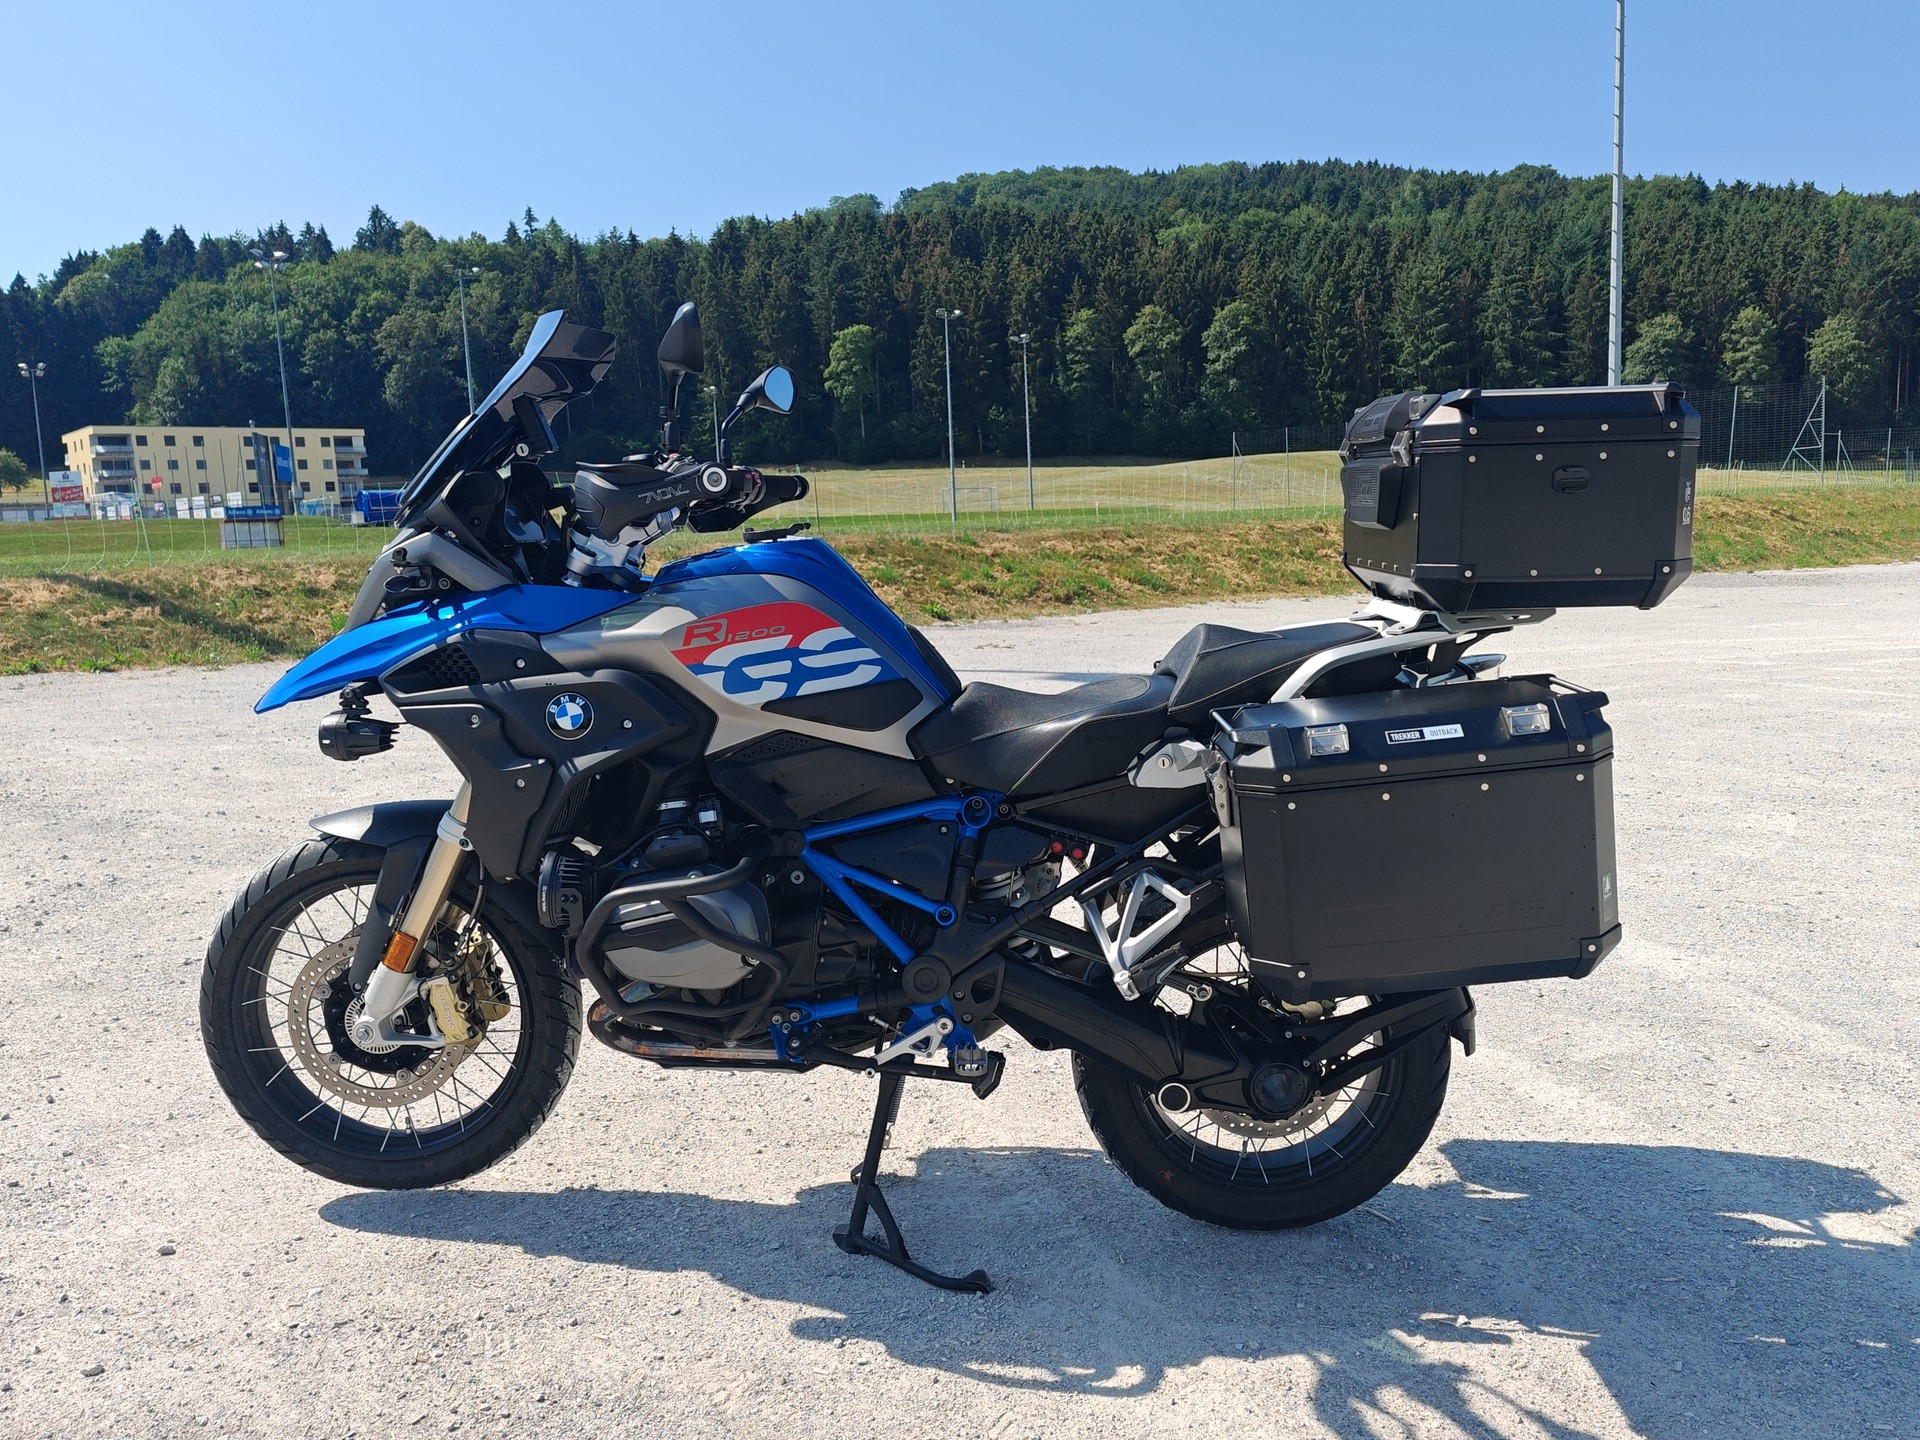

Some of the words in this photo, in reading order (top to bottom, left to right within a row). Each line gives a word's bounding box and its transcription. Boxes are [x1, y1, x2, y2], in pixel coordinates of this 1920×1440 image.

[645, 484, 683, 504] ADV
[697, 626, 882, 706] GS
[549, 695, 586, 713] BMW
[1390, 731, 1421, 742] TREKKER
[1429, 728, 1460, 737] OUTBACK
[439, 992, 456, 1031] brembo
